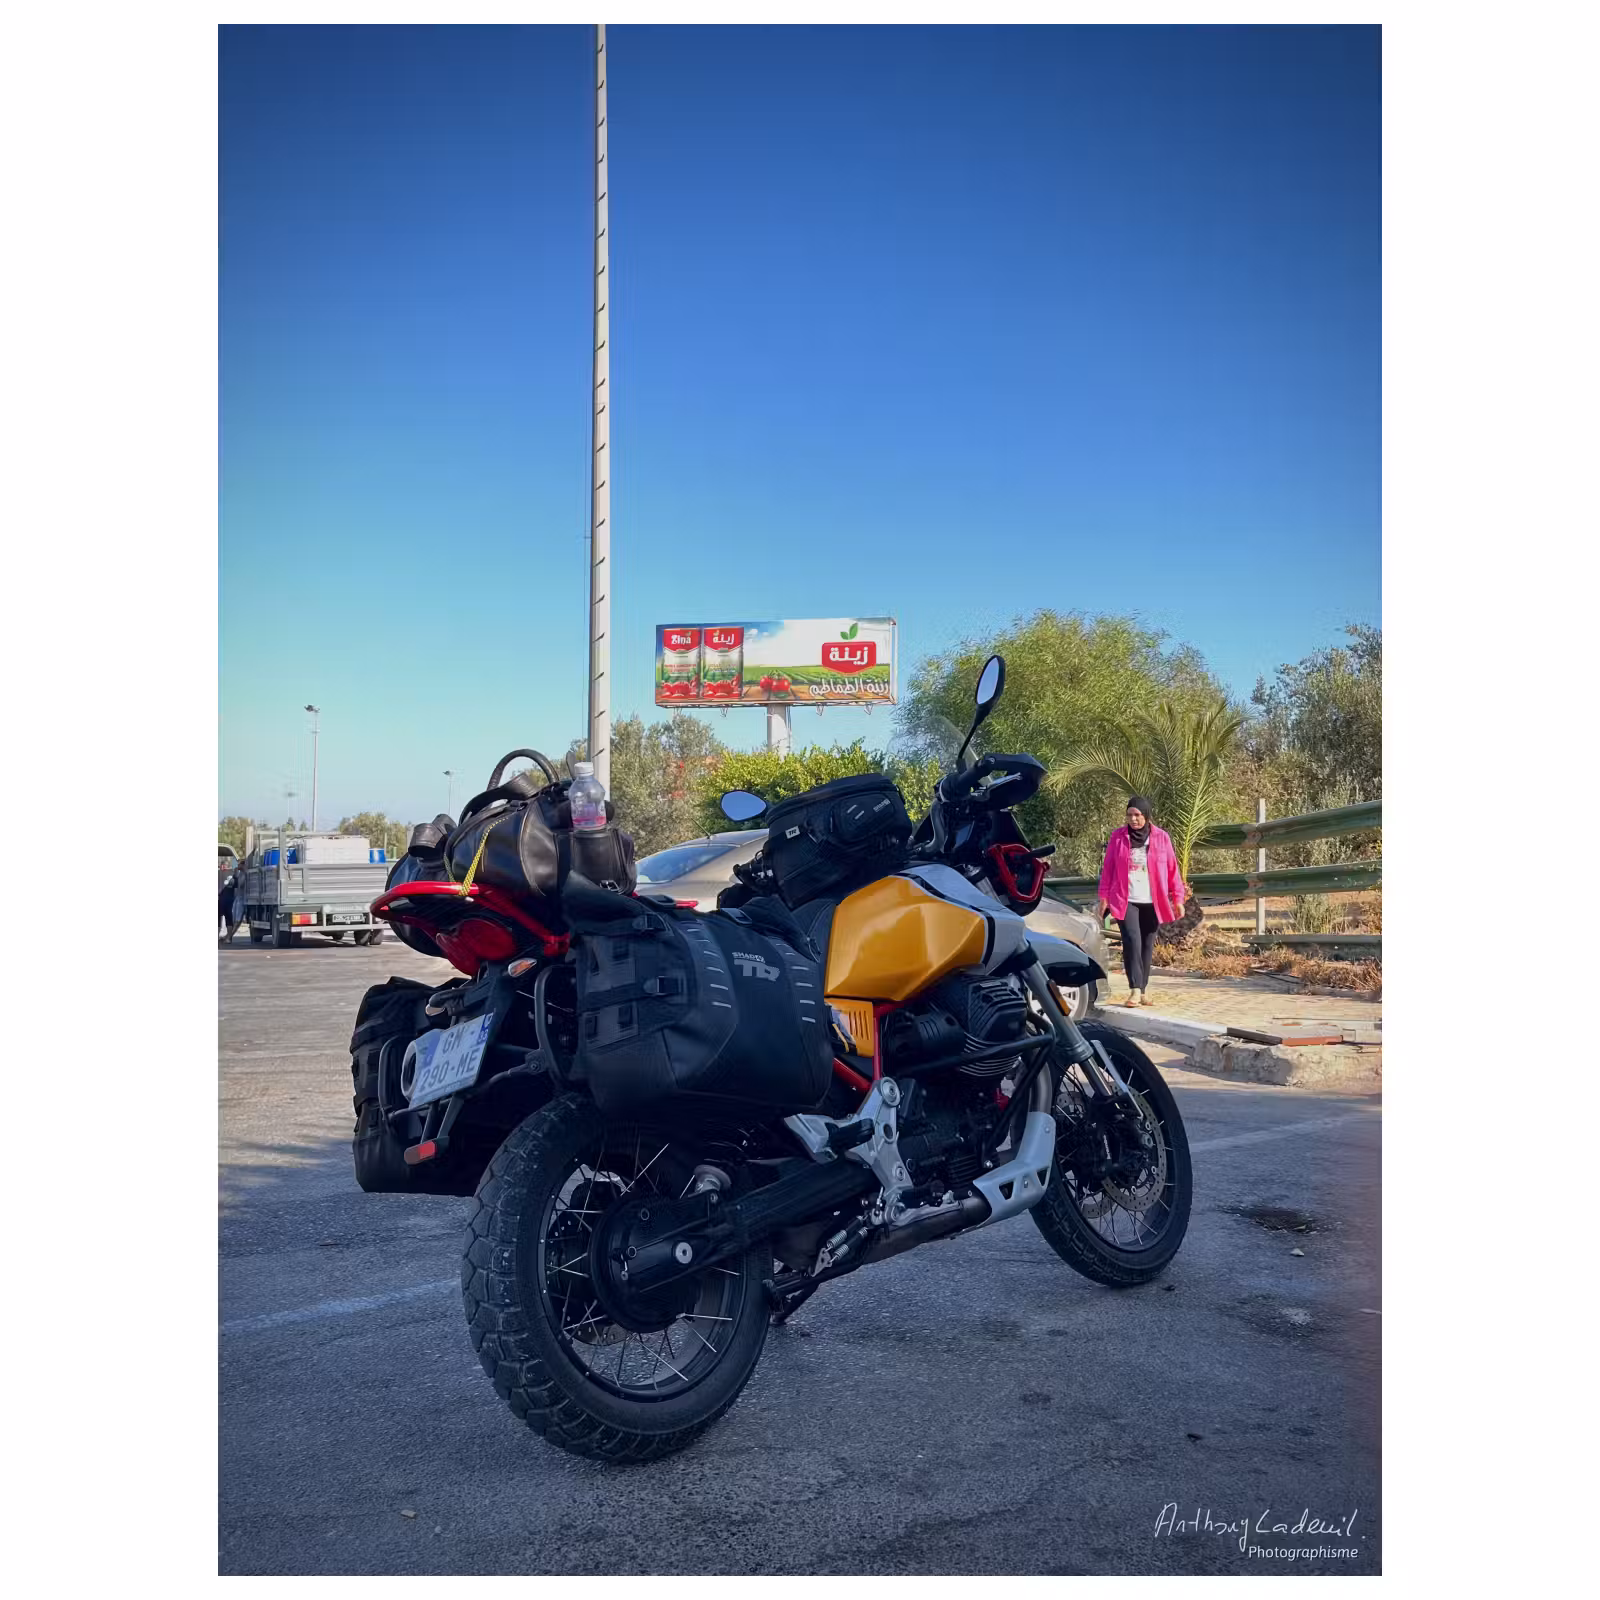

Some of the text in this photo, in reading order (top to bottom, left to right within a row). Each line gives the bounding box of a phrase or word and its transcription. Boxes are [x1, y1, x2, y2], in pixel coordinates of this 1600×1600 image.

[671, 633, 692, 645] Zina
[829, 646, 869, 665] زينة
[809, 677, 889, 697] زينة الطماطم
